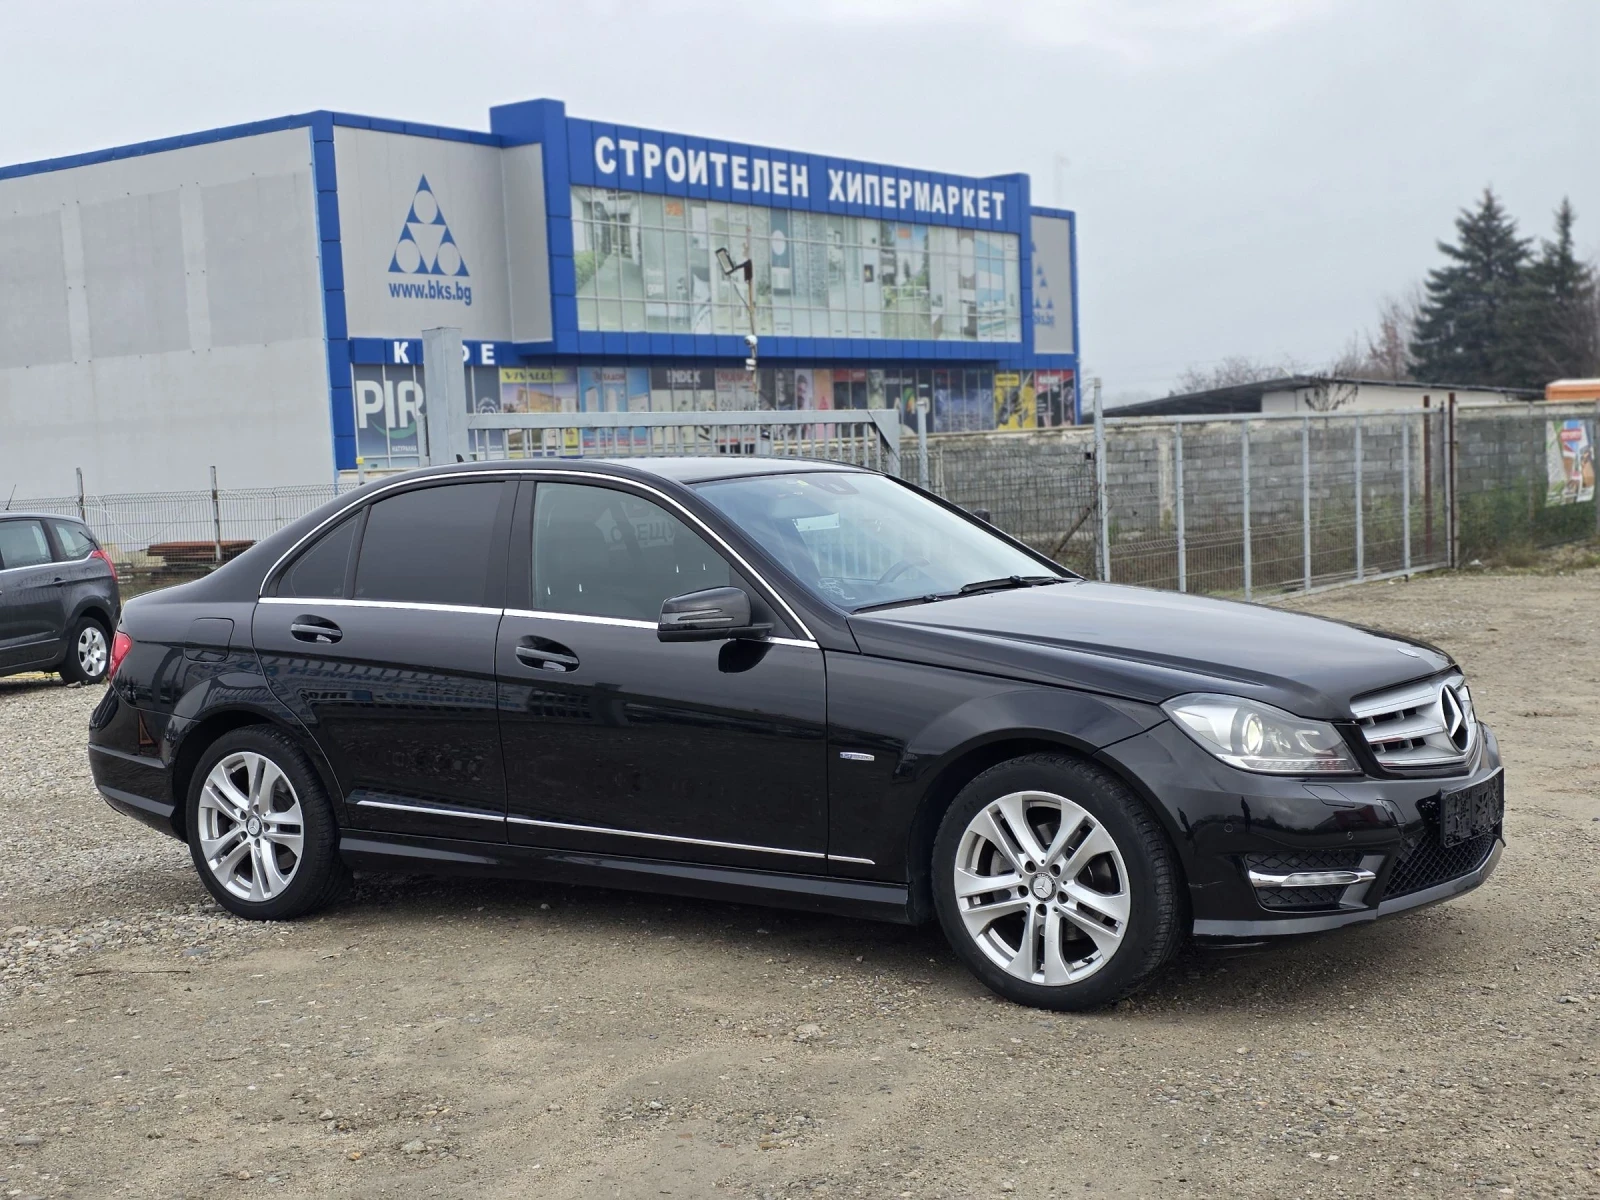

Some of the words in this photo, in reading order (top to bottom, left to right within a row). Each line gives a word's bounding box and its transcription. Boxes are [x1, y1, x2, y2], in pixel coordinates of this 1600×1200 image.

[594, 135, 809, 198] СТРОИТЕЛЕН
[827, 168, 1006, 221] ХИПЕРМАРКЕТ
[388, 279, 472, 307] www.bks.bg
